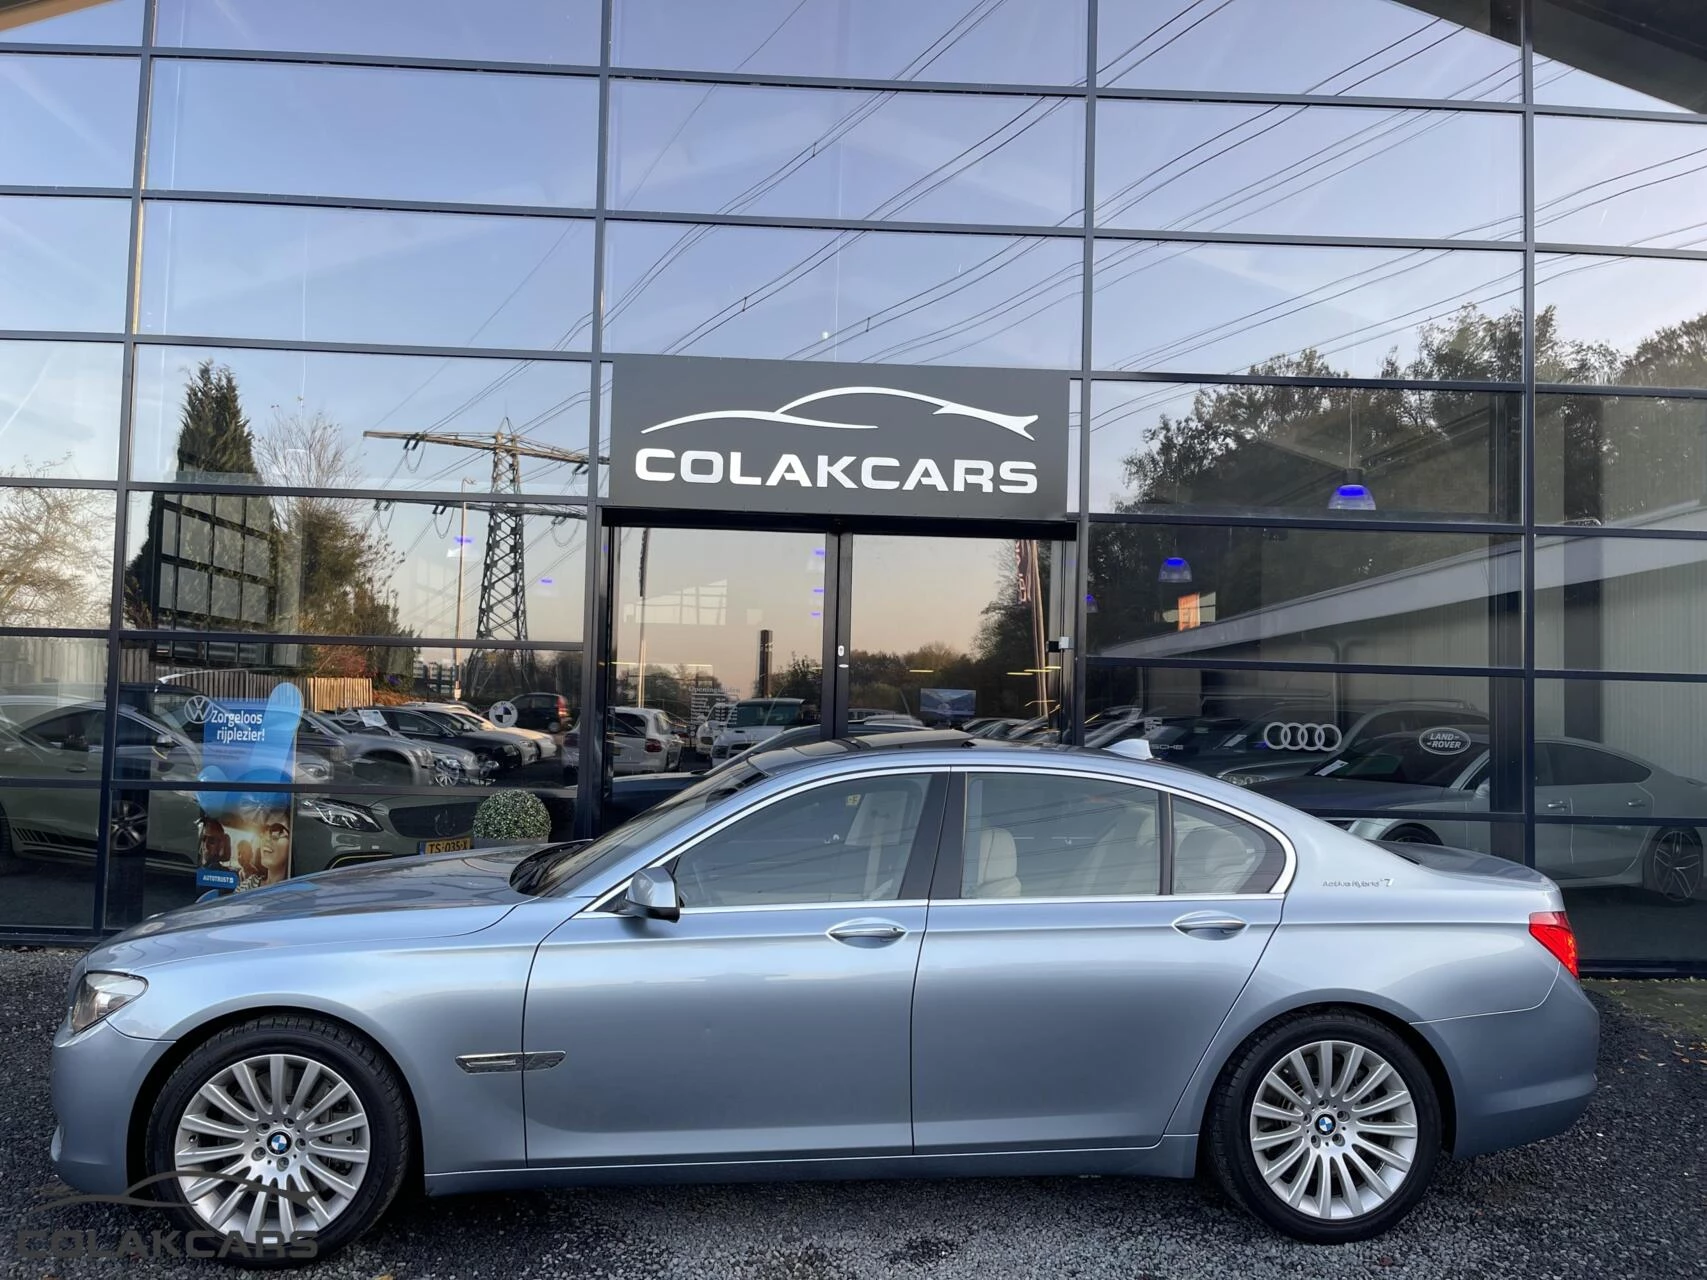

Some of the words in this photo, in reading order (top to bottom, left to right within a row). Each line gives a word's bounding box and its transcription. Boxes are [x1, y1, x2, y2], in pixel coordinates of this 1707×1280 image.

[635, 447, 1039, 495] COLAKCARS
[211, 710, 263, 727] Zorgeloos
[216, 727, 265, 744] rijplezier!
[1430, 732, 1454, 741] LAND
[1431, 740, 1462, 749] ROVER
[202, 874, 229, 883] AUTOTRUST
